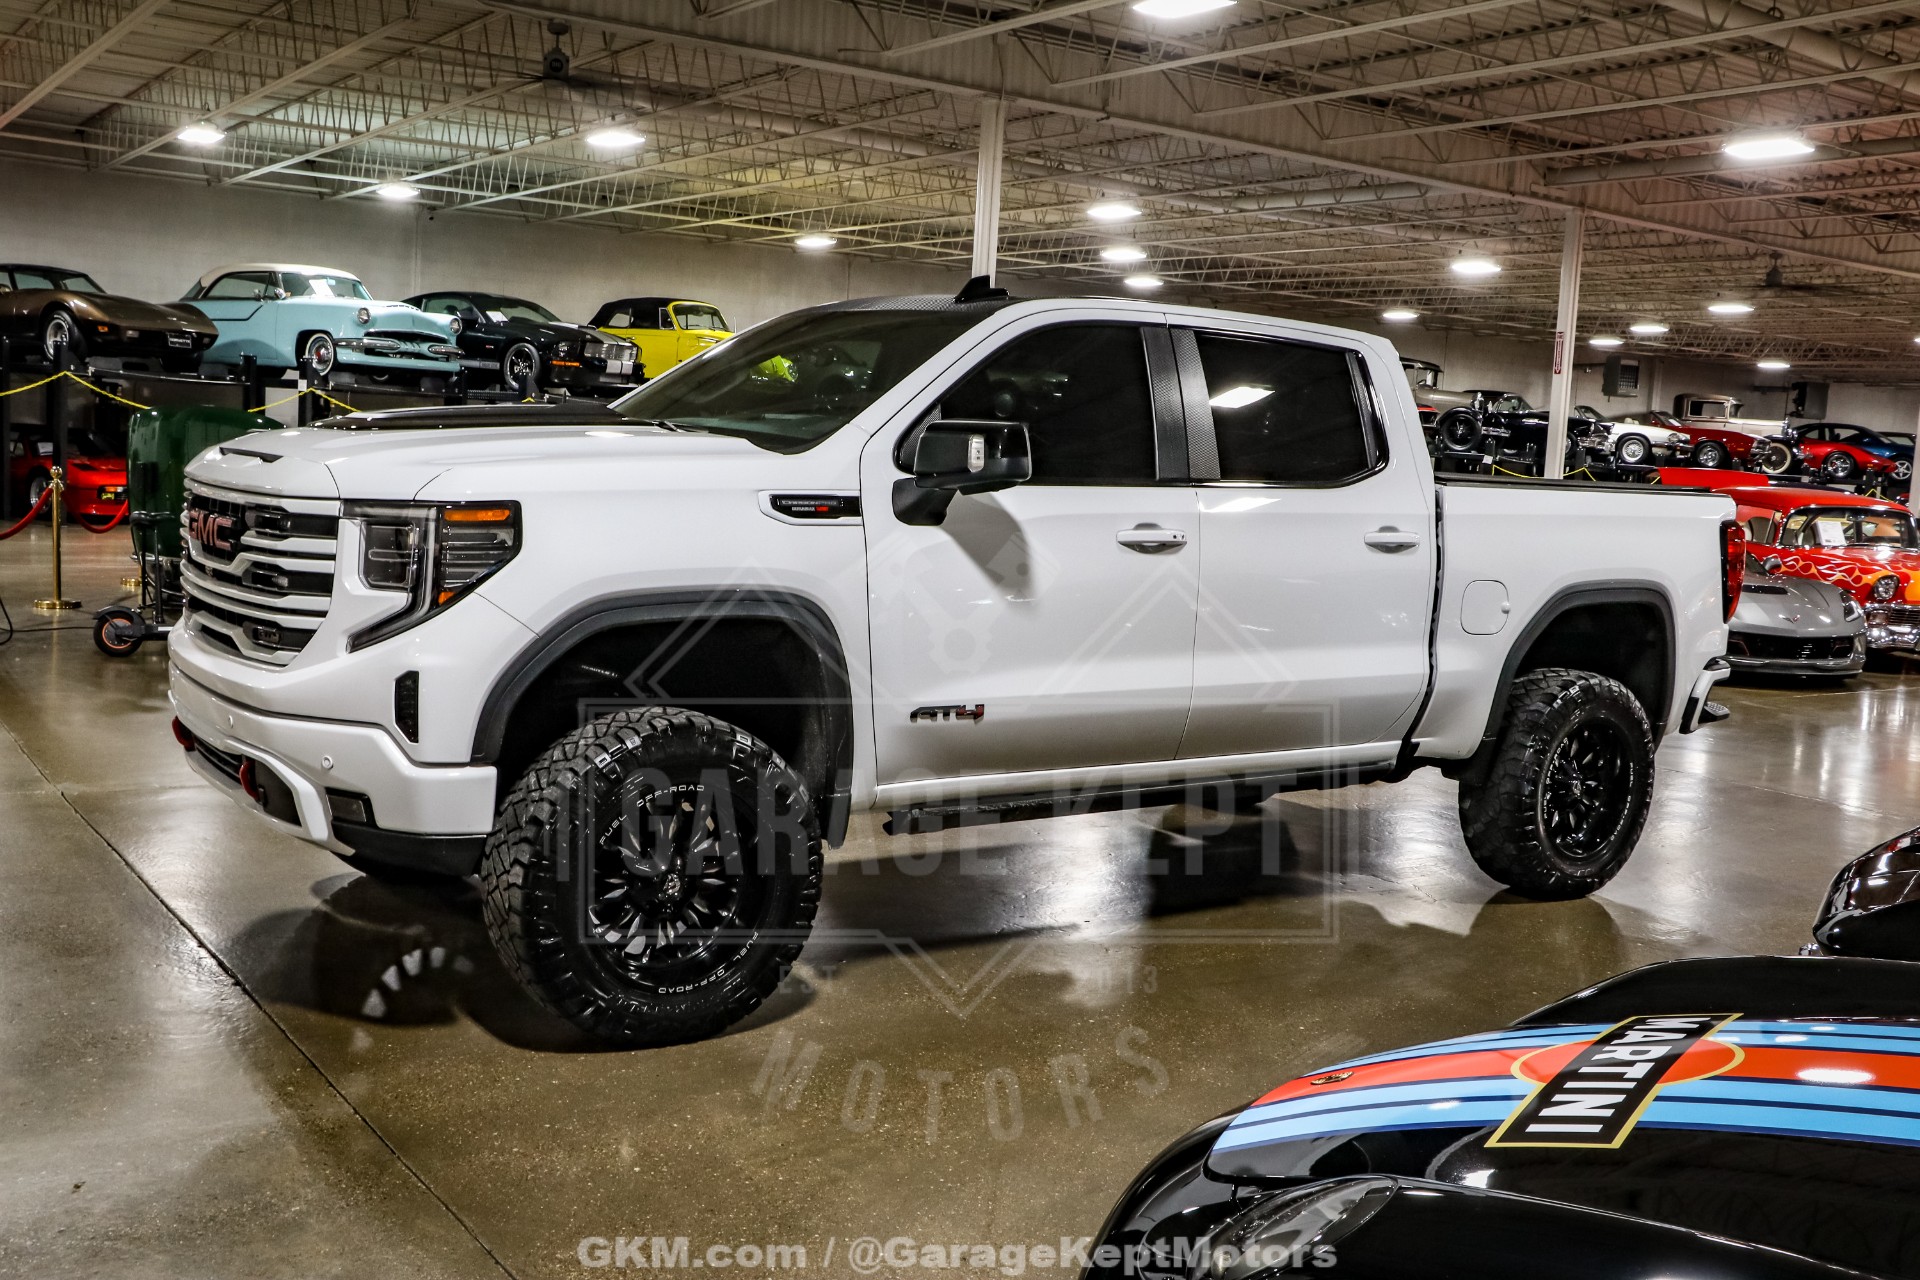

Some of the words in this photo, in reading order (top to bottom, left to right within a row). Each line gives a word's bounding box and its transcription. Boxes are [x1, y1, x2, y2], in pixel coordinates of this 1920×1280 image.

[189, 507, 233, 552] GMC
[599, 814, 628, 846] FUEL
[636, 784, 705, 808] OFF-ROAD
[732, 931, 759, 962] FUEL
[658, 967, 725, 994] OFF-ROAD
[1524, 1016, 1712, 1133] MARTINI
